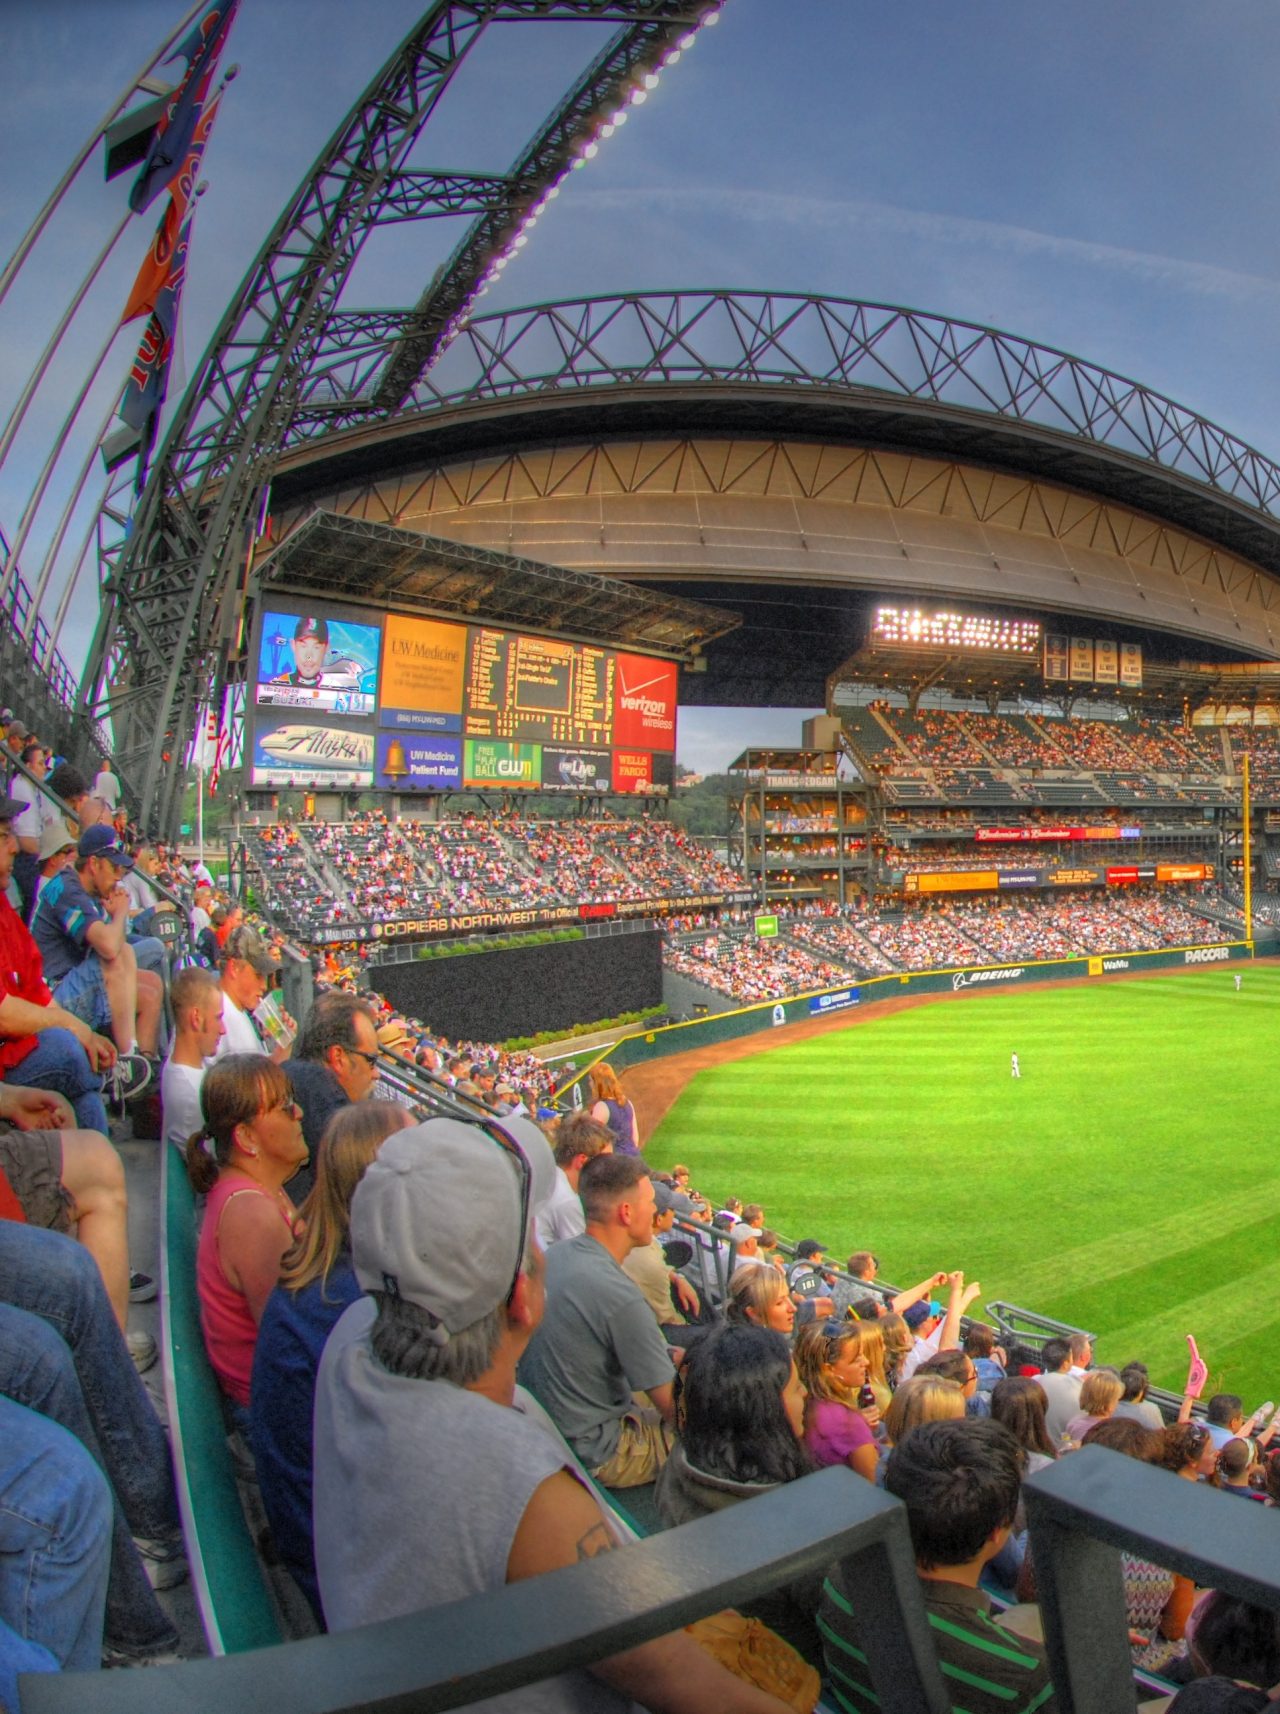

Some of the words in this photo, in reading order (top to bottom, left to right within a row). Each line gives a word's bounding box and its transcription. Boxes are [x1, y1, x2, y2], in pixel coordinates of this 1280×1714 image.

[391, 639, 413, 656] UW
[412, 641, 460, 663] Medicine
[274, 694, 312, 706] SUZUKI
[621, 695, 666, 717] verizon
[642, 716, 673, 730] wireless
[287, 729, 358, 758] Alaska
[410, 750, 424, 760] UW
[424, 752, 455, 762] Medicine
[479, 746, 495, 756] FREE
[481, 756, 497, 766] PLAY
[618, 755, 648, 766] WELLS
[410, 765, 438, 775] Patient
[439, 766, 459, 776] Fund
[475, 765, 497, 777] BALL
[570, 760, 596, 777] Live
[619, 767, 648, 777] FARGO
[766, 776, 799, 788] THANKS
[978, 829, 1020, 840] Budweiser
[1031, 828, 1070, 839] Budweiser
[384, 918, 448, 937] COPIERS
[451, 910, 538, 931] NORTHWEST
[556, 907, 579, 919] Official
[159, 922, 176, 935] 181
[1184, 947, 1230, 963] PACCAR
[1103, 960, 1129, 971] WaMu
[969, 968, 1021, 982] BOEING
[802, 1279, 816, 1290] 181
